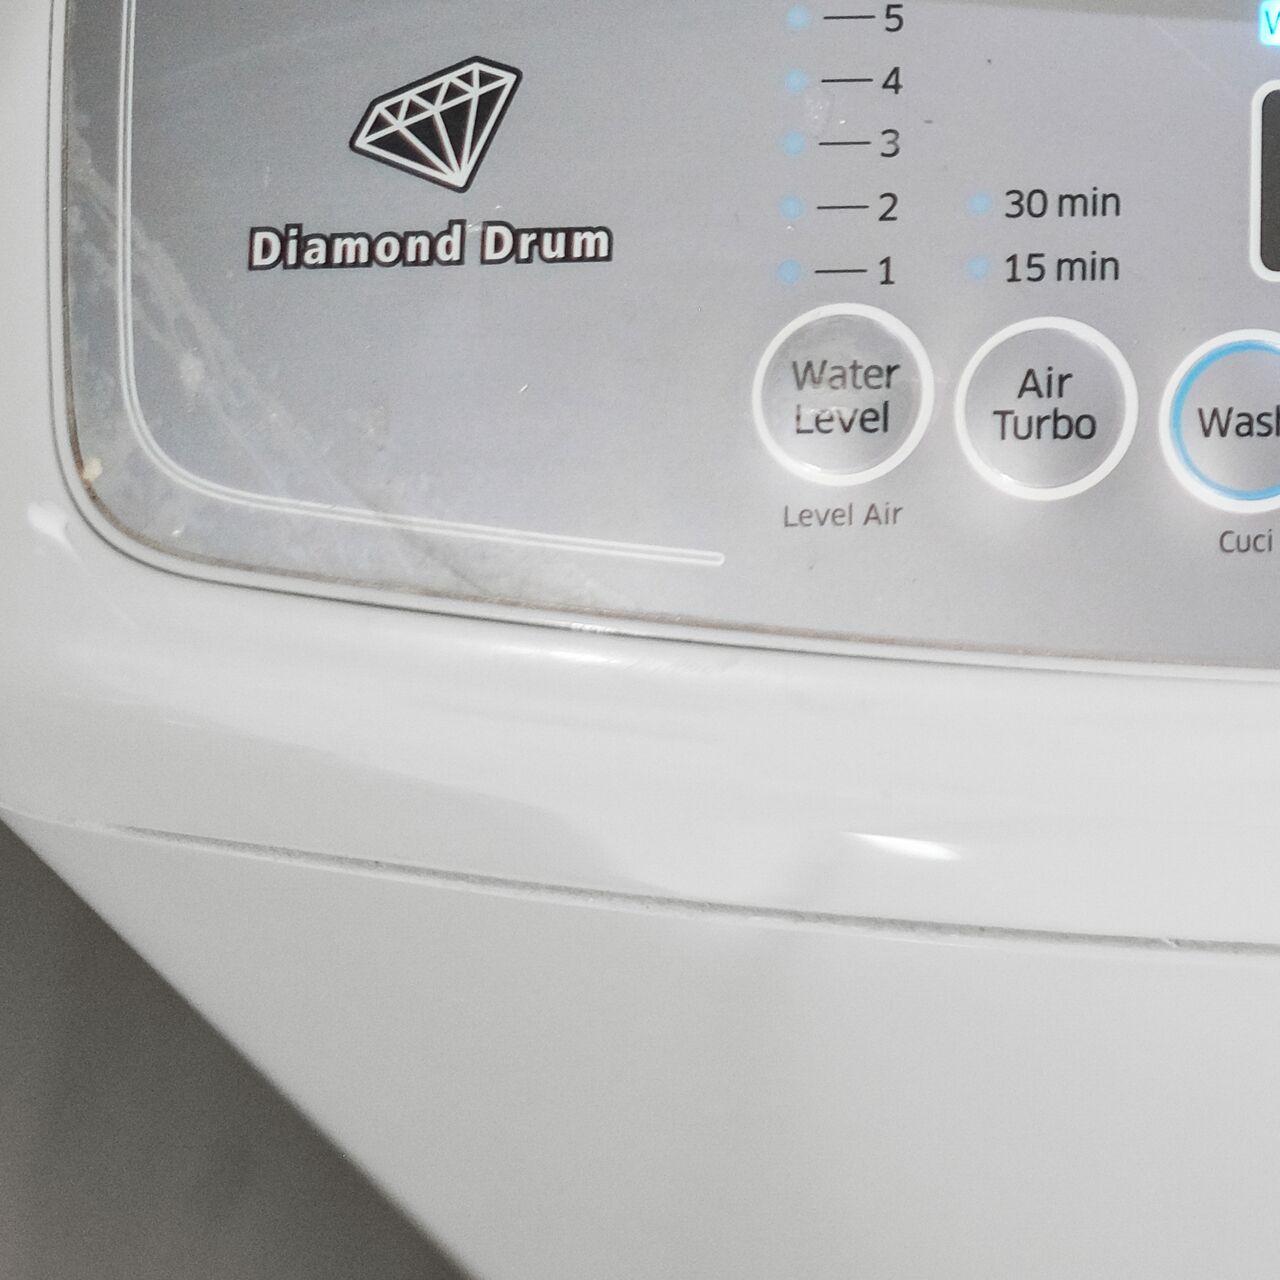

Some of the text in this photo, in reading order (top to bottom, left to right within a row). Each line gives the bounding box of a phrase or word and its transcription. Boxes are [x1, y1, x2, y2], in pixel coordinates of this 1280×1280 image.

[885, 4, 904, 32] 5
[882, 66, 903, 95] 4
[880, 129, 900, 158] 3
[878, 193, 898, 221] 2
[1005, 186, 1121, 218] 30 min
[249, 220, 612, 270] Diamond Drum
[879, 257, 895, 285] 1
[1006, 251, 1119, 282] 15 min
[792, 360, 900, 391] Water
[1018, 366, 1073, 399] Air
[796, 401, 889, 435] Level
[993, 408, 1096, 441] Turbo
[783, 502, 903, 528] Level Air
[1219, 528, 1273, 554] Cuci
